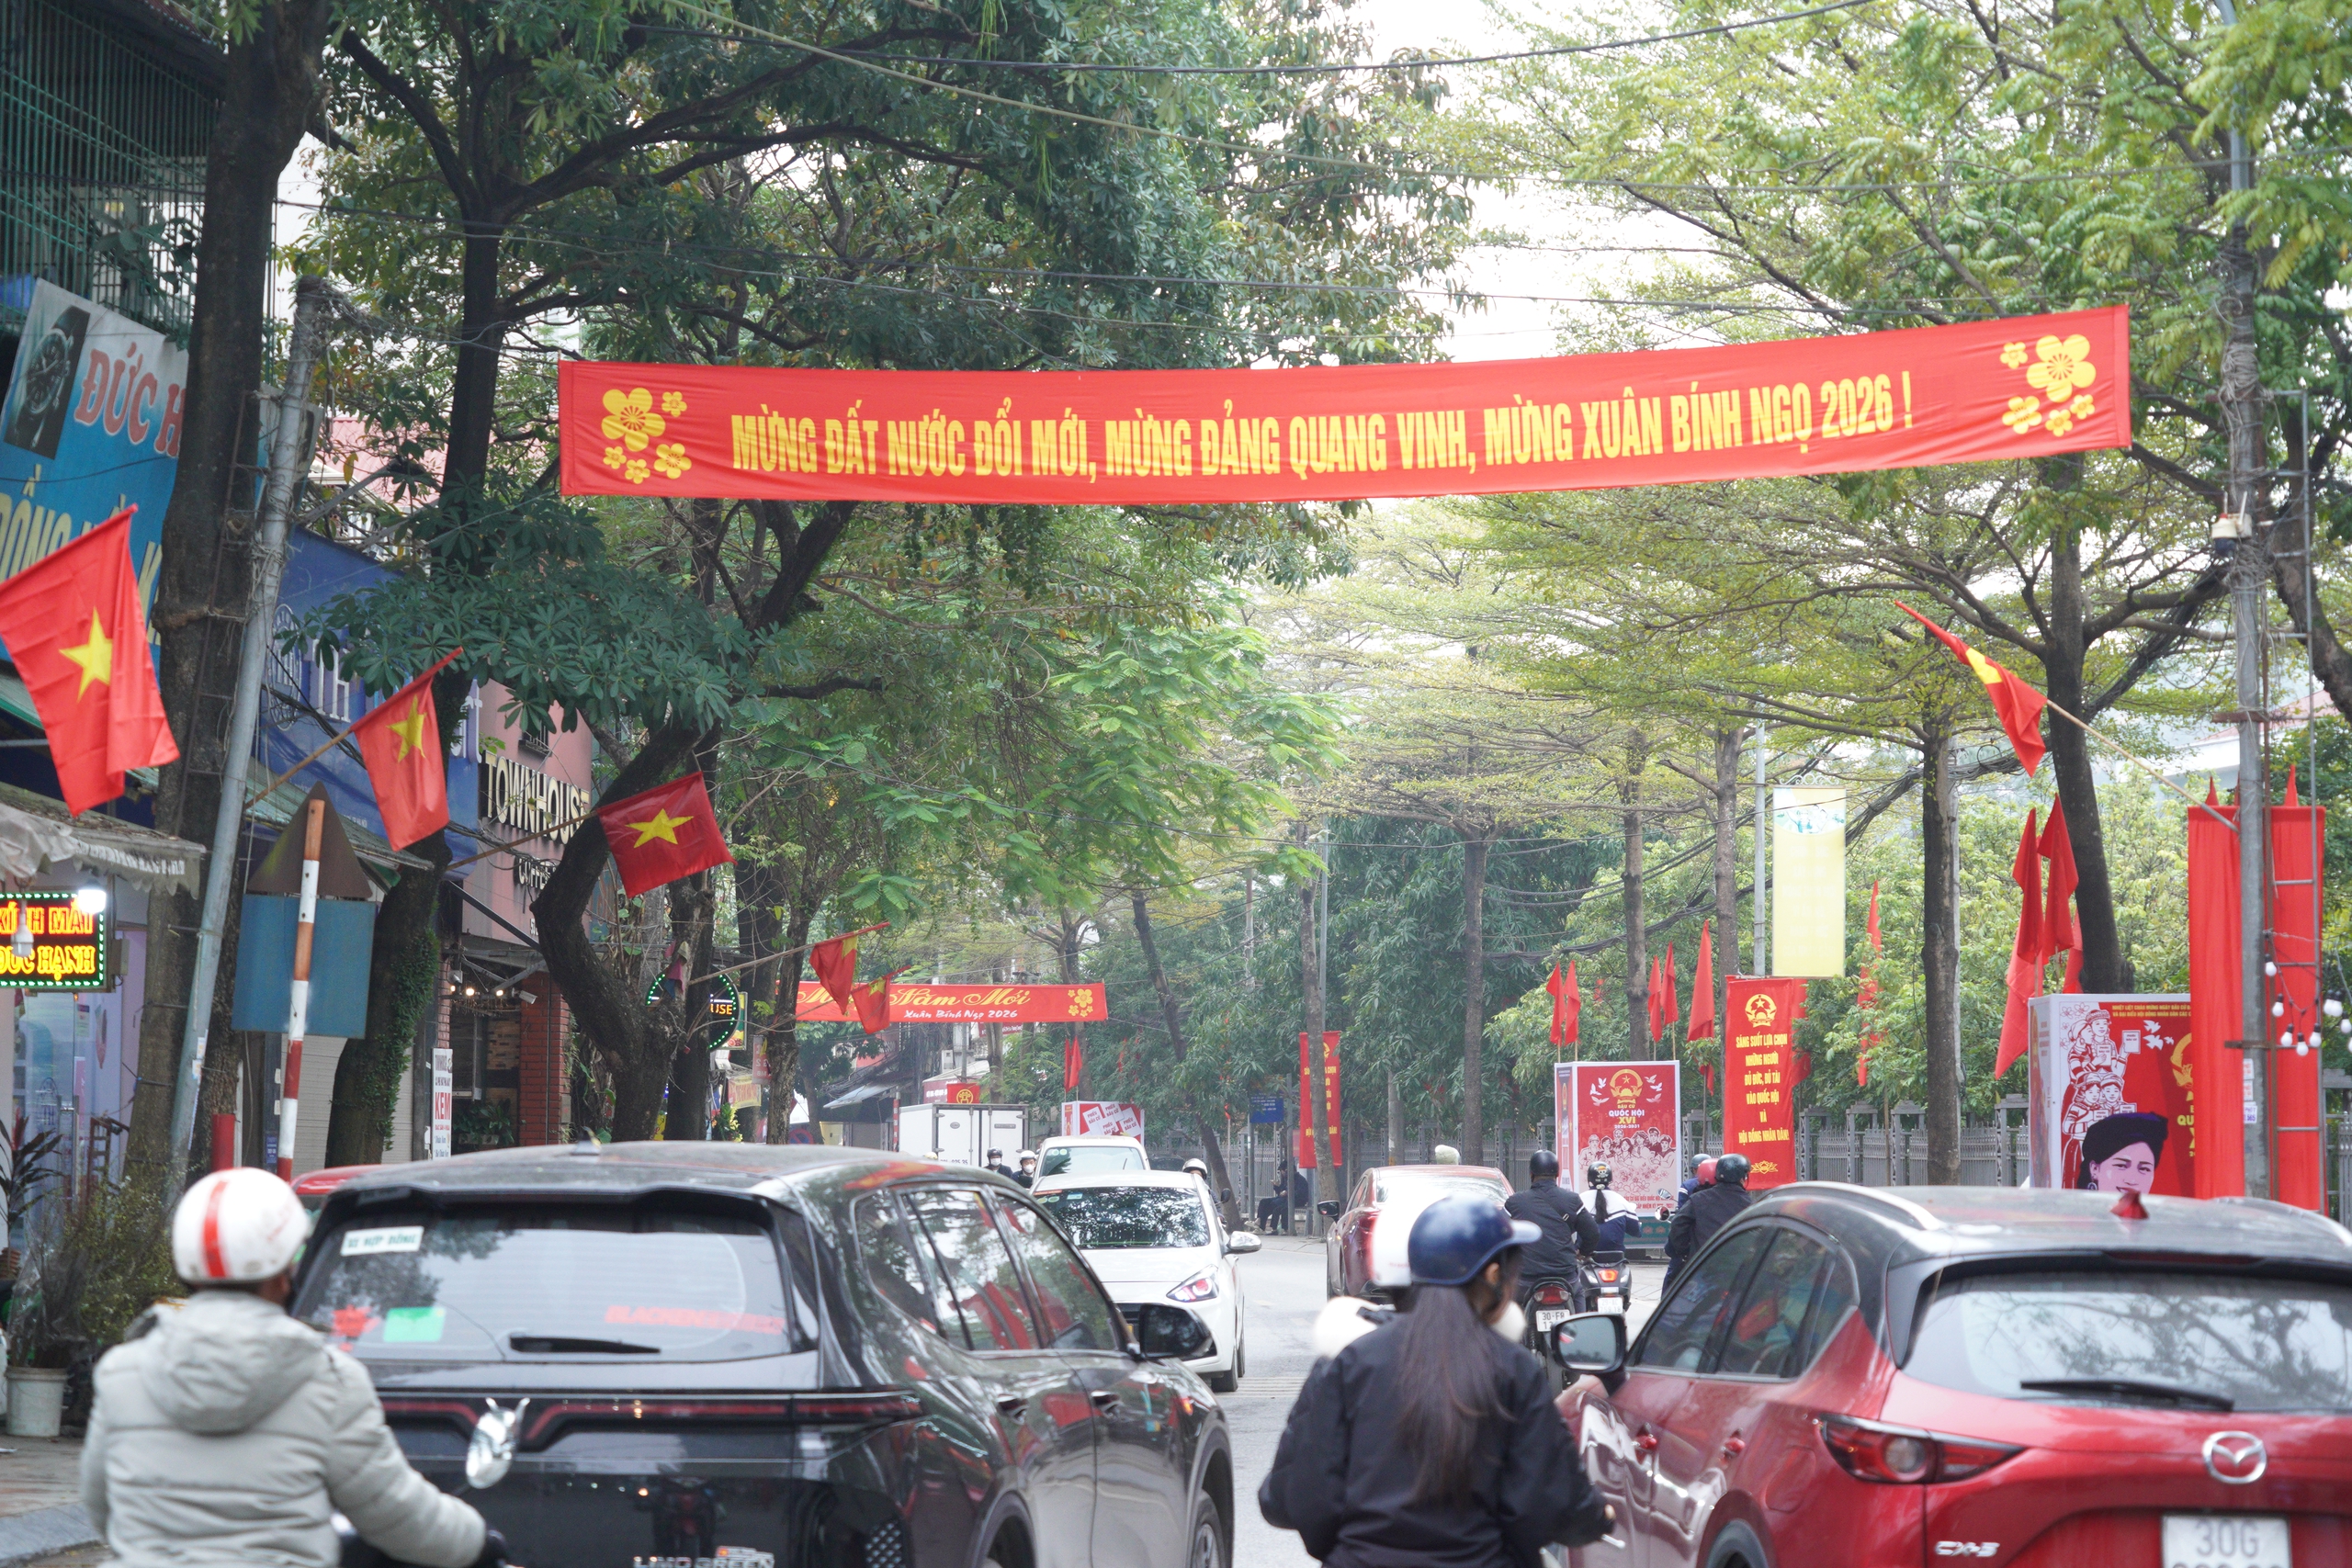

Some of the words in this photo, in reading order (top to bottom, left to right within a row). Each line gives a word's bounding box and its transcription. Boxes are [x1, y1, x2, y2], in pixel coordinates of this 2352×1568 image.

[74, 341, 158, 445] ĐỨC
[731, 403, 818, 473] MỪNG
[825, 399, 879, 475] ĐẤT
[887, 408, 965, 477] NƯỚC
[974, 396, 1023, 477] ĐỔI
[1031, 407, 1097, 484] MỚI,
[1105, 408, 1192, 477] MỪNG
[1200, 399, 1281, 476] ĐẢNG
[1289, 414, 1387, 480] QUANG
[1396, 410, 1476, 474] VINH,
[1484, 394, 1574, 466] MỪNG
[1580, 386, 1664, 459] XUÂN
[1671, 381, 1743, 452] BÍNH
[1749, 381, 1813, 454] NGỌ
[1821, 373, 1894, 439] 2026
[37, 945, 96, 981] HẠNH
[435, 1092, 451, 1120] KEM
[1934, 1540, 2001, 1558] CX-5
[2194, 1517, 2262, 1559] 30G
